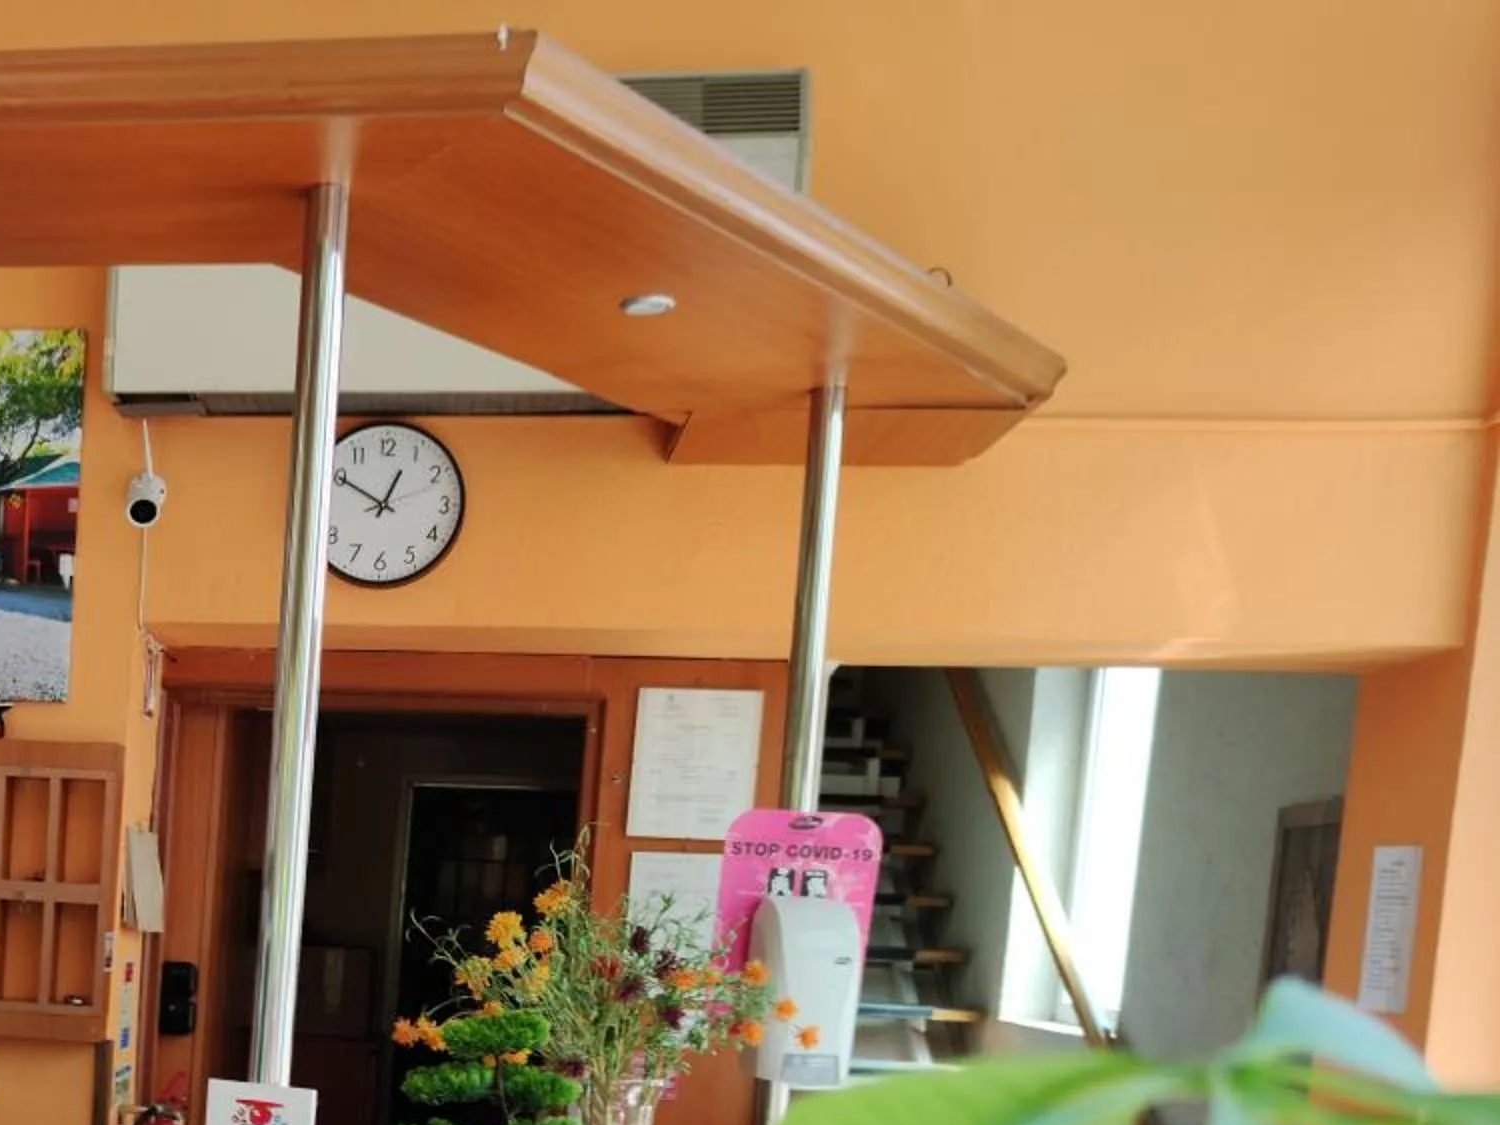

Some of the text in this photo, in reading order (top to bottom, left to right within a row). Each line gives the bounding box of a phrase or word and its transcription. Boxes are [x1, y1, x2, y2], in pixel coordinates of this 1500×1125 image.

[352, 447, 366, 465] 11
[380, 437, 397, 458] 12
[412, 446, 419, 463] 1
[429, 465, 442, 484] 2
[439, 496, 451, 515] 3
[426, 525, 438, 542] 4
[349, 543, 363, 563] 7
[373, 551, 388, 571] 6
[403, 546, 416, 564] 5
[731, 841, 874, 862] STOP COVID-19
